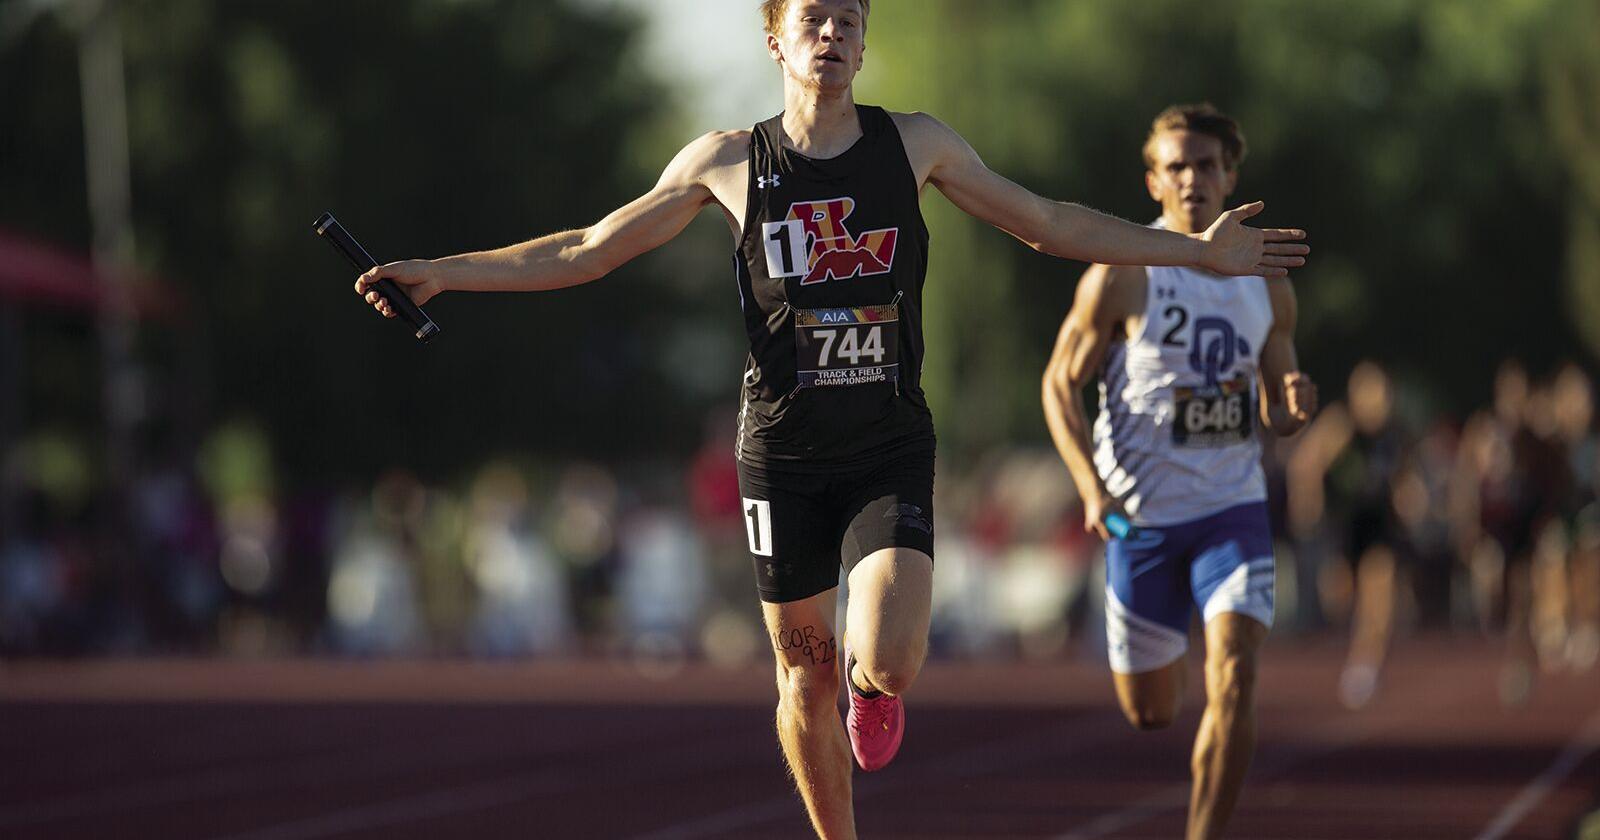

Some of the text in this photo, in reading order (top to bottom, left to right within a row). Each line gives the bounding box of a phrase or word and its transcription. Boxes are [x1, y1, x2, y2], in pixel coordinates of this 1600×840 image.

[770, 225, 794, 273] 1
[822, 312, 848, 322] AIA
[1162, 305, 1187, 346] 2
[813, 326, 885, 366] 744
[814, 374, 885, 386] CHAMPIONSHIPS
[819, 368, 882, 378] TRACK & FIELD
[1185, 396, 1242, 432] 646
[747, 504, 761, 551] 1
